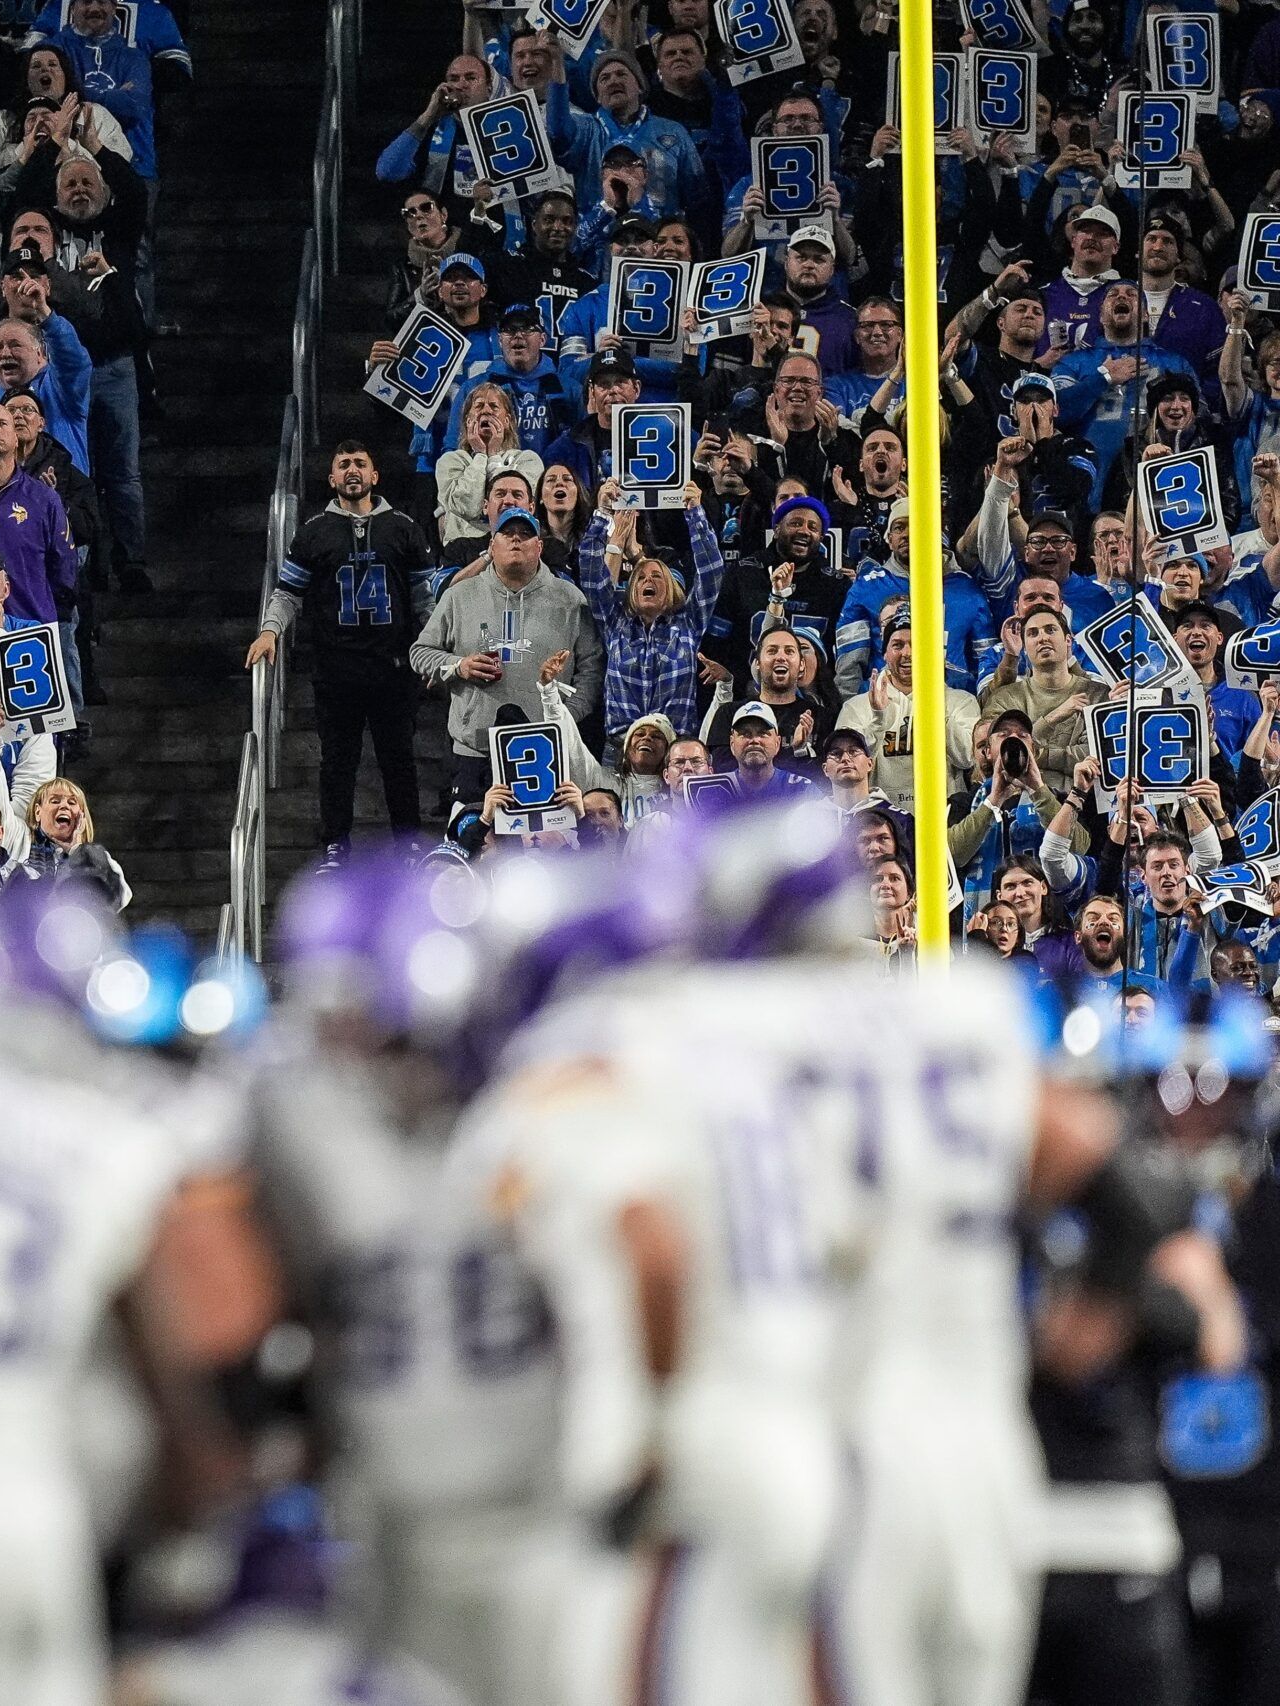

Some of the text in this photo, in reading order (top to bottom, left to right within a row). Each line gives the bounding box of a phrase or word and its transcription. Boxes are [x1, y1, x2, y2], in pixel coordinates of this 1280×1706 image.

[730, 0, 778, 52] 3
[1166, 24, 1207, 85] 3
[982, 62, 1021, 124] 3
[482, 107, 535, 173] 3
[1133, 101, 1181, 165] 3
[772, 148, 814, 209] 3
[541, 282, 578, 298] LIONS
[625, 269, 673, 334] 3
[703, 262, 751, 313] 3
[400, 326, 454, 394] 3
[629, 415, 676, 482] 3
[1155, 462, 1205, 530] 3
[1200, 535, 1219, 543] ROCKET
[335, 564, 393, 627] 14
[4, 638, 53, 709] 3
[1102, 612, 1170, 692] 3
[506, 734, 556, 805] 3
[1142, 714, 1191, 783] 3
